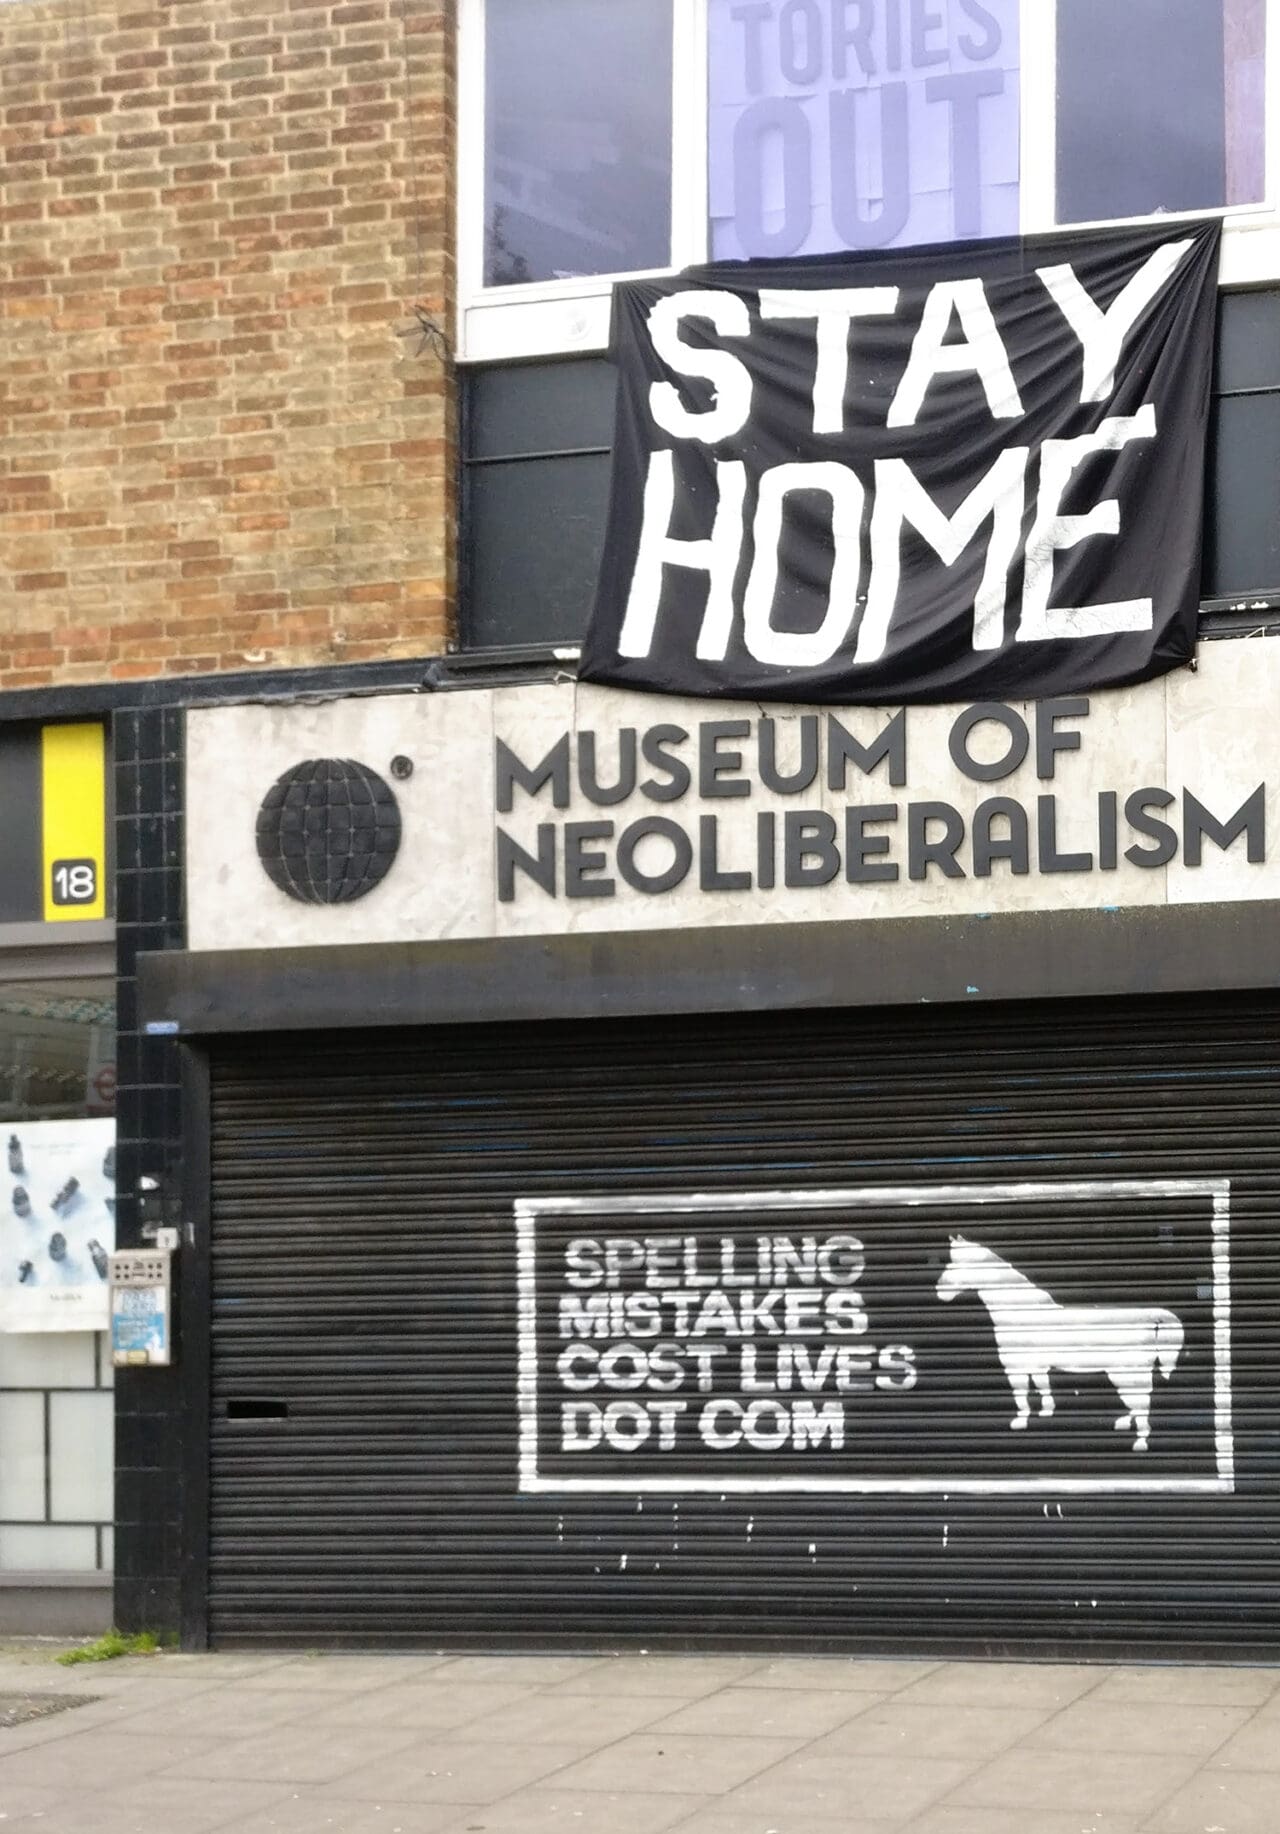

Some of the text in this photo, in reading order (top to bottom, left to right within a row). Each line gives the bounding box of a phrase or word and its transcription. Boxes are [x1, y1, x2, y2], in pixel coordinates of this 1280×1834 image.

[731, 0, 1002, 96] TORIES
[733, 68, 1004, 257] OUT
[646, 239, 1195, 444] STAY
[617, 404, 1156, 666] HOME
[496, 698, 1090, 812] MUSEUM OF
[55, 865, 95, 899] 18
[497, 781, 1266, 902] NEOLIBERALISM
[564, 1236, 866, 1288] SPELLING
[559, 1288, 869, 1338] MISTAKES
[557, 1344, 918, 1391] COST LIVES
[561, 1399, 845, 1451] DOT COM
